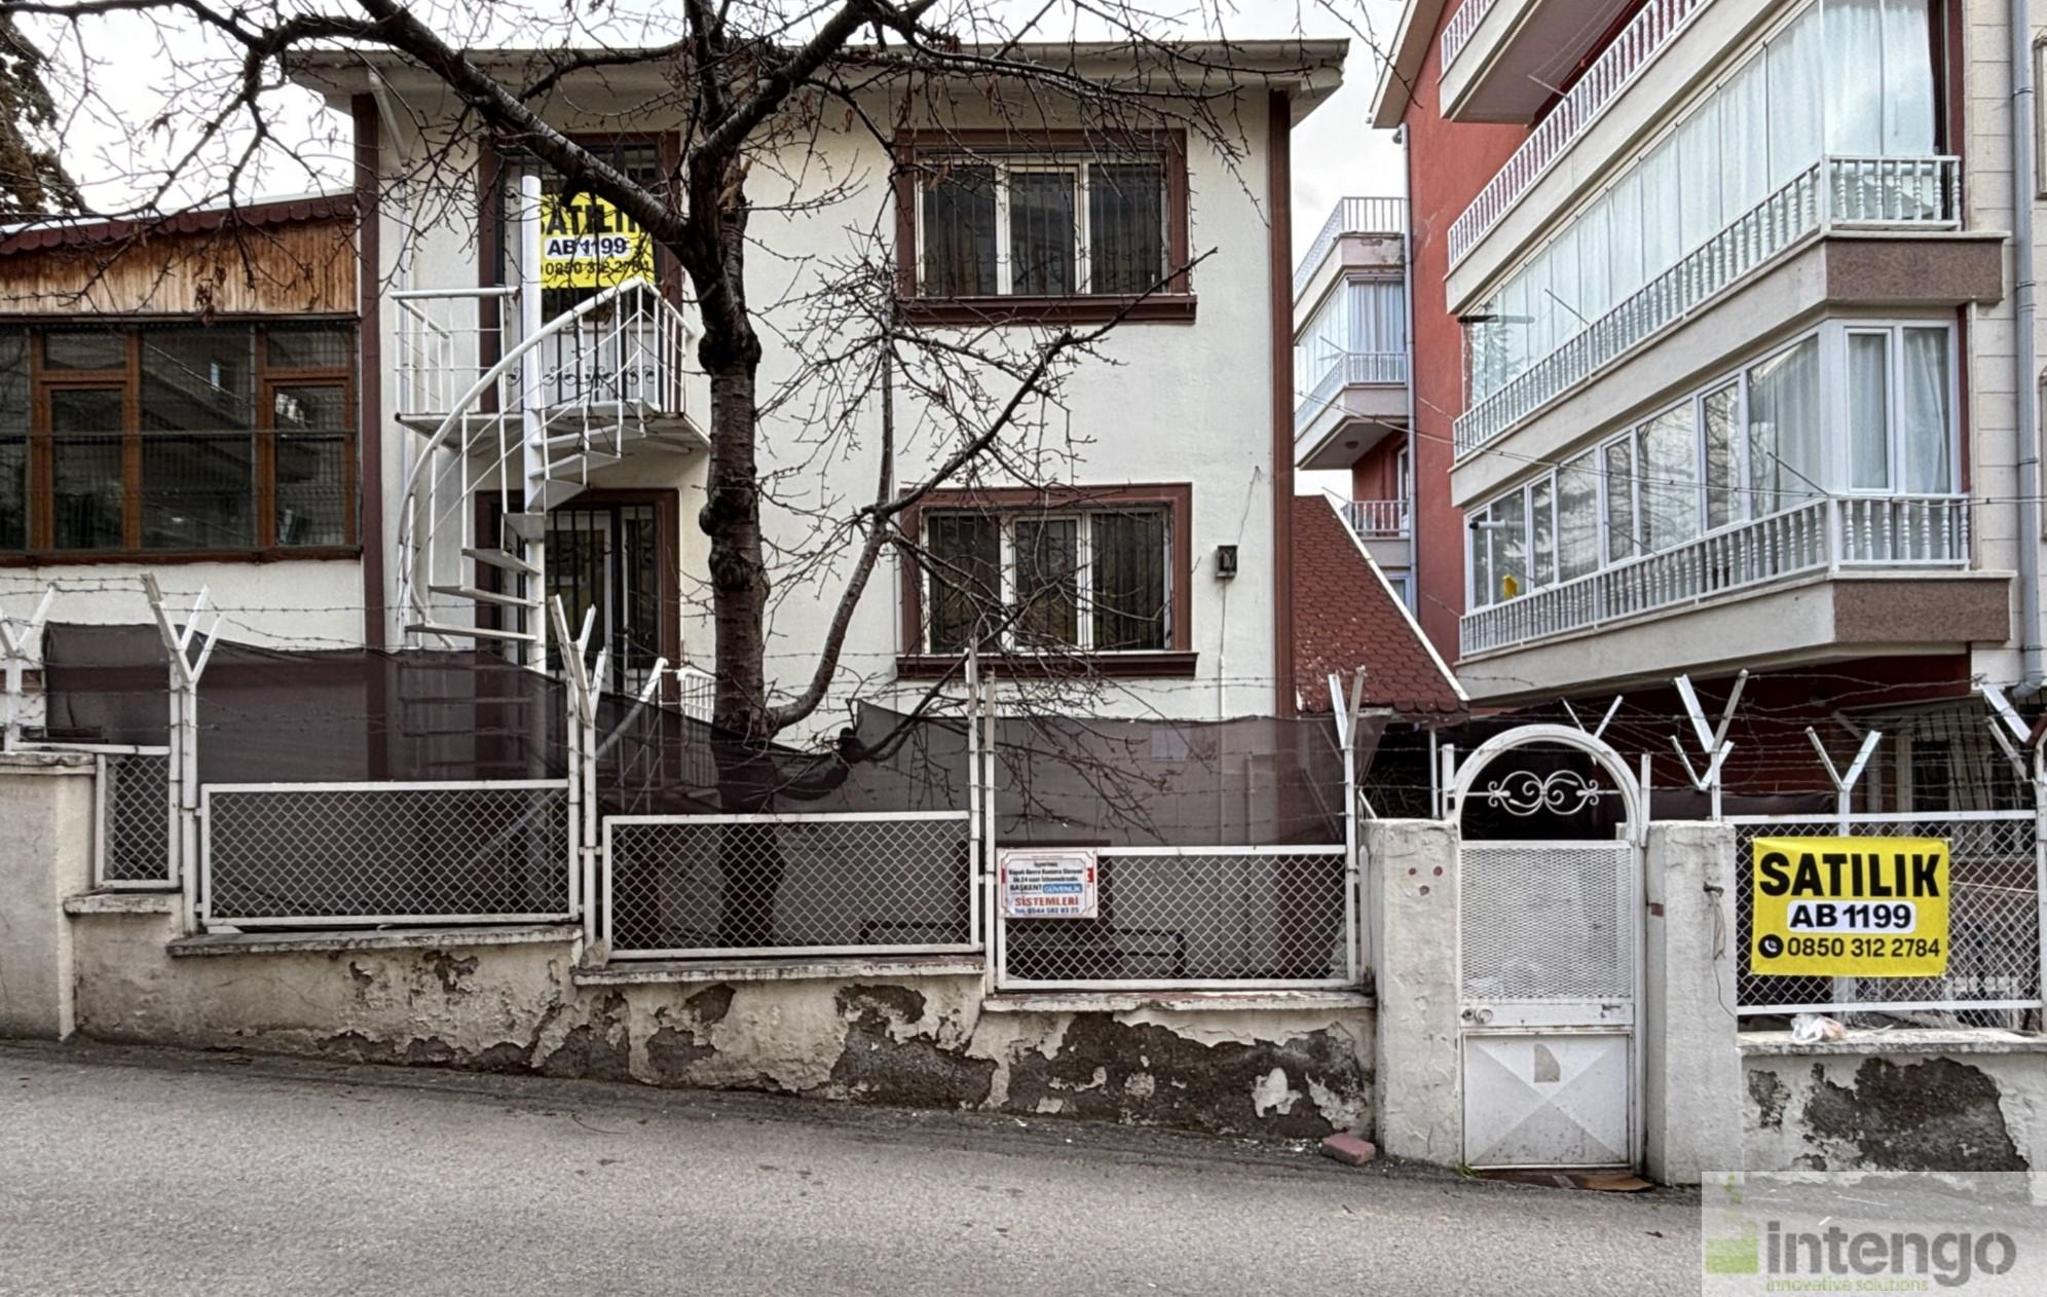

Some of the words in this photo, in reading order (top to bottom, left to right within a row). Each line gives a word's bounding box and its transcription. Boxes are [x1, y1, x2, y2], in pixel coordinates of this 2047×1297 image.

[540, 204, 640, 235] ATILI
[547, 240, 577, 255] AB
[587, 261, 610, 274] 32
[1759, 852, 1941, 897] SATILIK
[1015, 896, 1079, 906] SİSTEMLERİ
[1789, 904, 1838, 928] AB
[1843, 904, 1912, 928] 1199
[1787, 938, 1844, 957] 0850
[1850, 938, 1885, 957] 312
[1891, 938, 1940, 957] 2784
